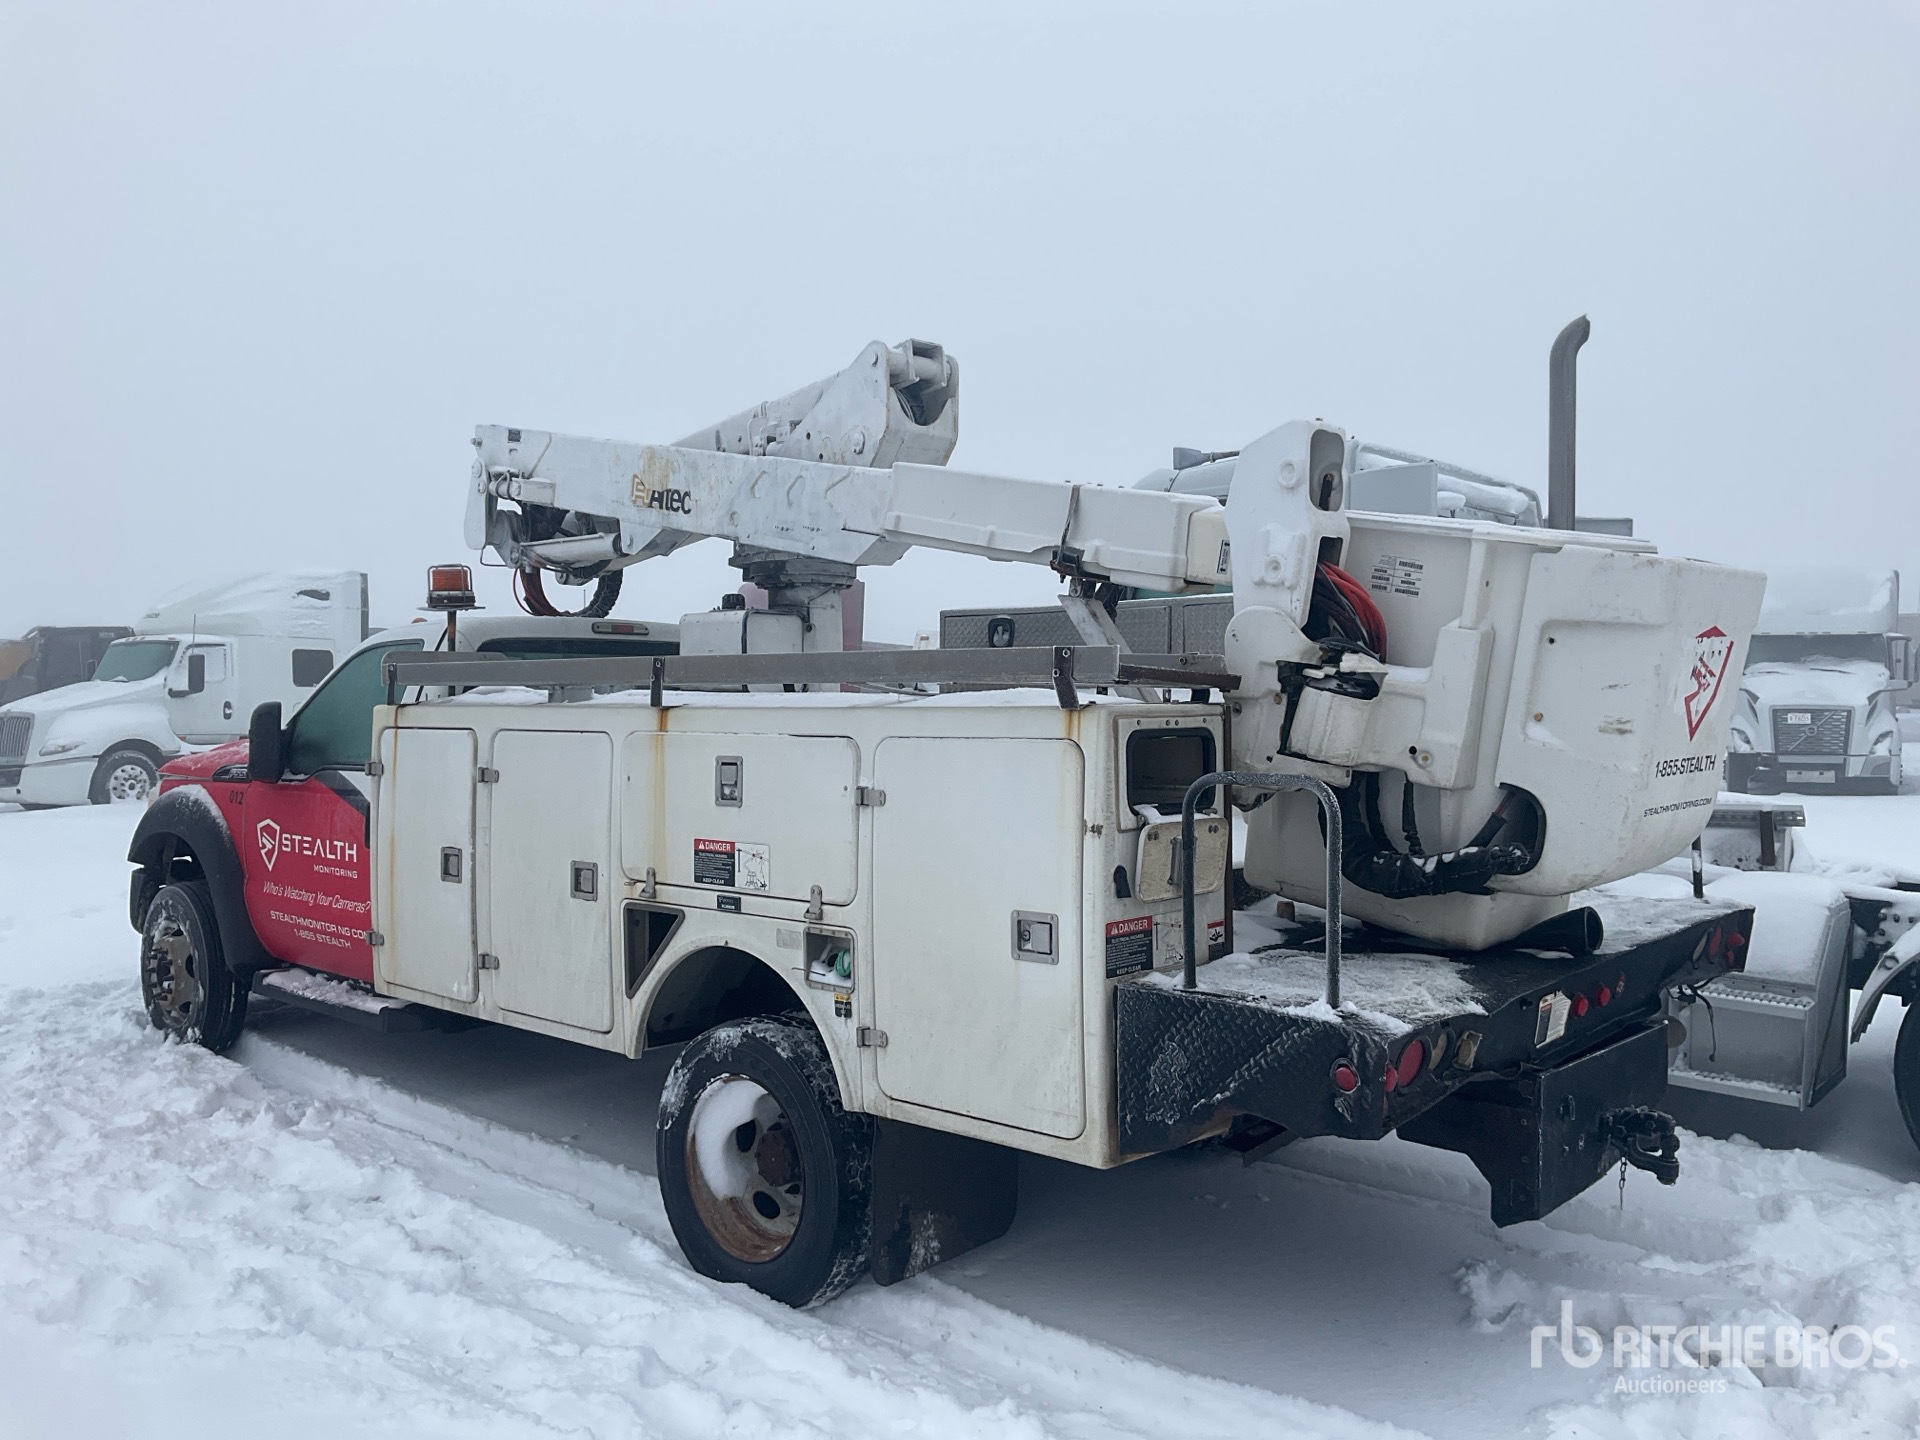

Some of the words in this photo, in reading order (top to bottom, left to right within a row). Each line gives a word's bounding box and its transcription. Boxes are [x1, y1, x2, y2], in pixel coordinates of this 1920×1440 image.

[1655, 754, 1717, 778] 1-855-STEALTH
[229, 790, 244, 805] 012
[281, 833, 357, 863] STEALTH
[705, 841, 731, 852] DANGER
[313, 864, 358, 879] MONITORING
[263, 881, 284, 896] Who's
[284, 885, 316, 907] Watching
[316, 891, 333, 906] Your
[332, 894, 371, 914] Cameras?
[1118, 919, 1148, 933] DANGER
